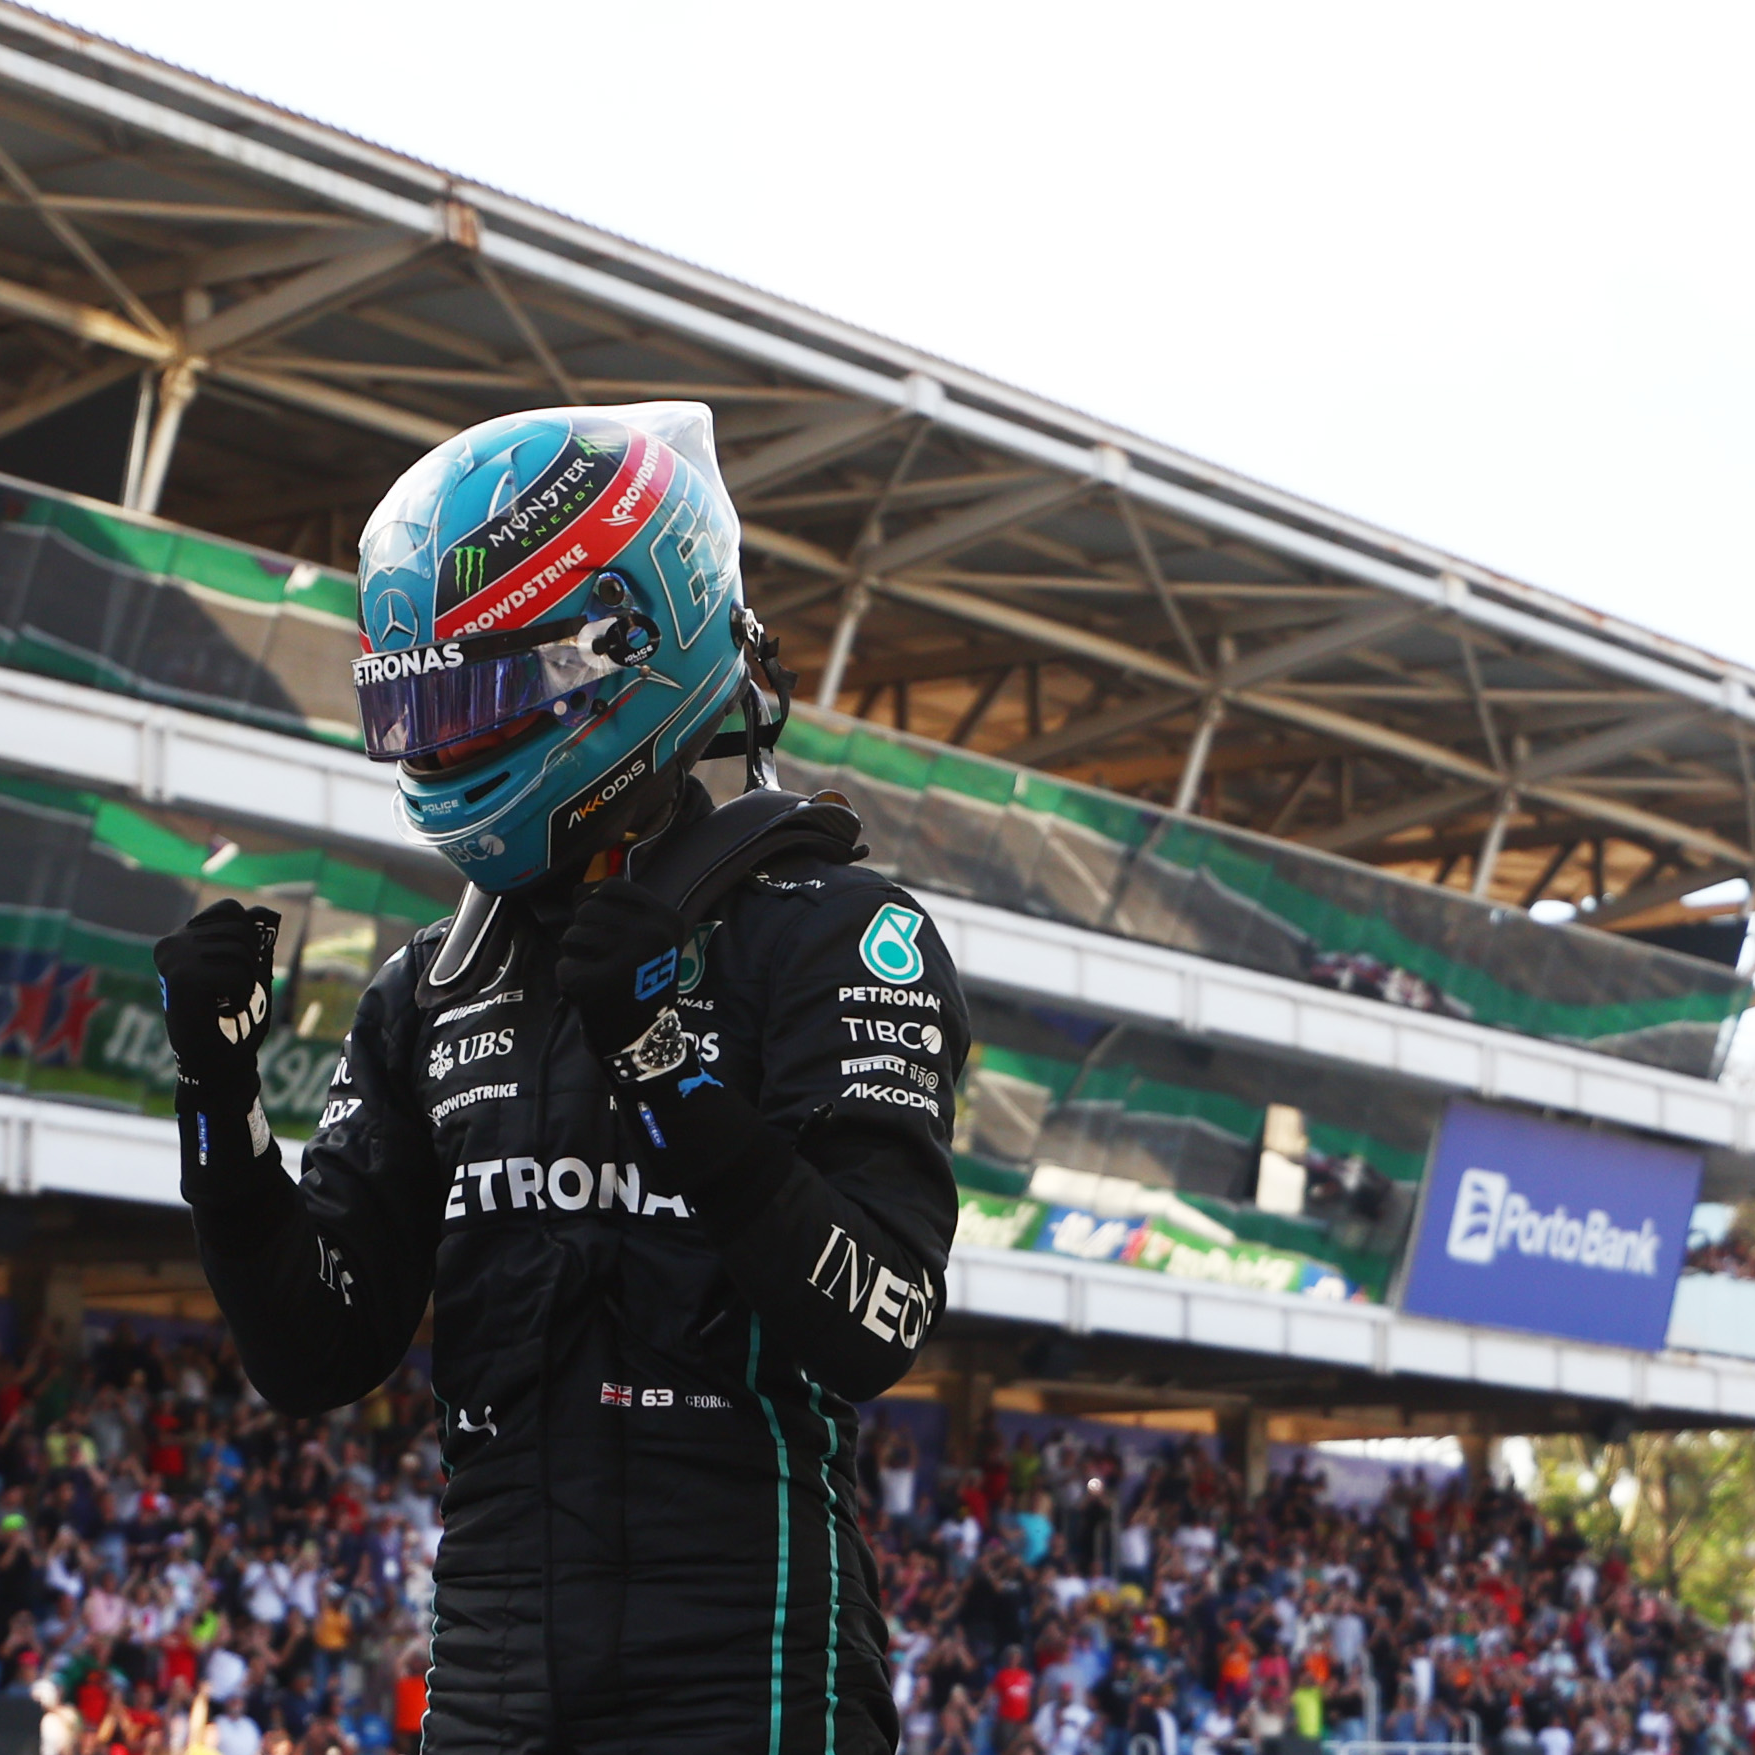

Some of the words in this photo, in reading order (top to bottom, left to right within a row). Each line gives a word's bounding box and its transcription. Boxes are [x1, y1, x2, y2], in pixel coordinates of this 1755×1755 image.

[488, 457, 595, 547] MONSTER
[521, 480, 595, 548] ENERGY
[458, 1028, 515, 1065] UBS
[1498, 1192, 1660, 1276] PortoBank
[641, 1389, 674, 1407] 63
